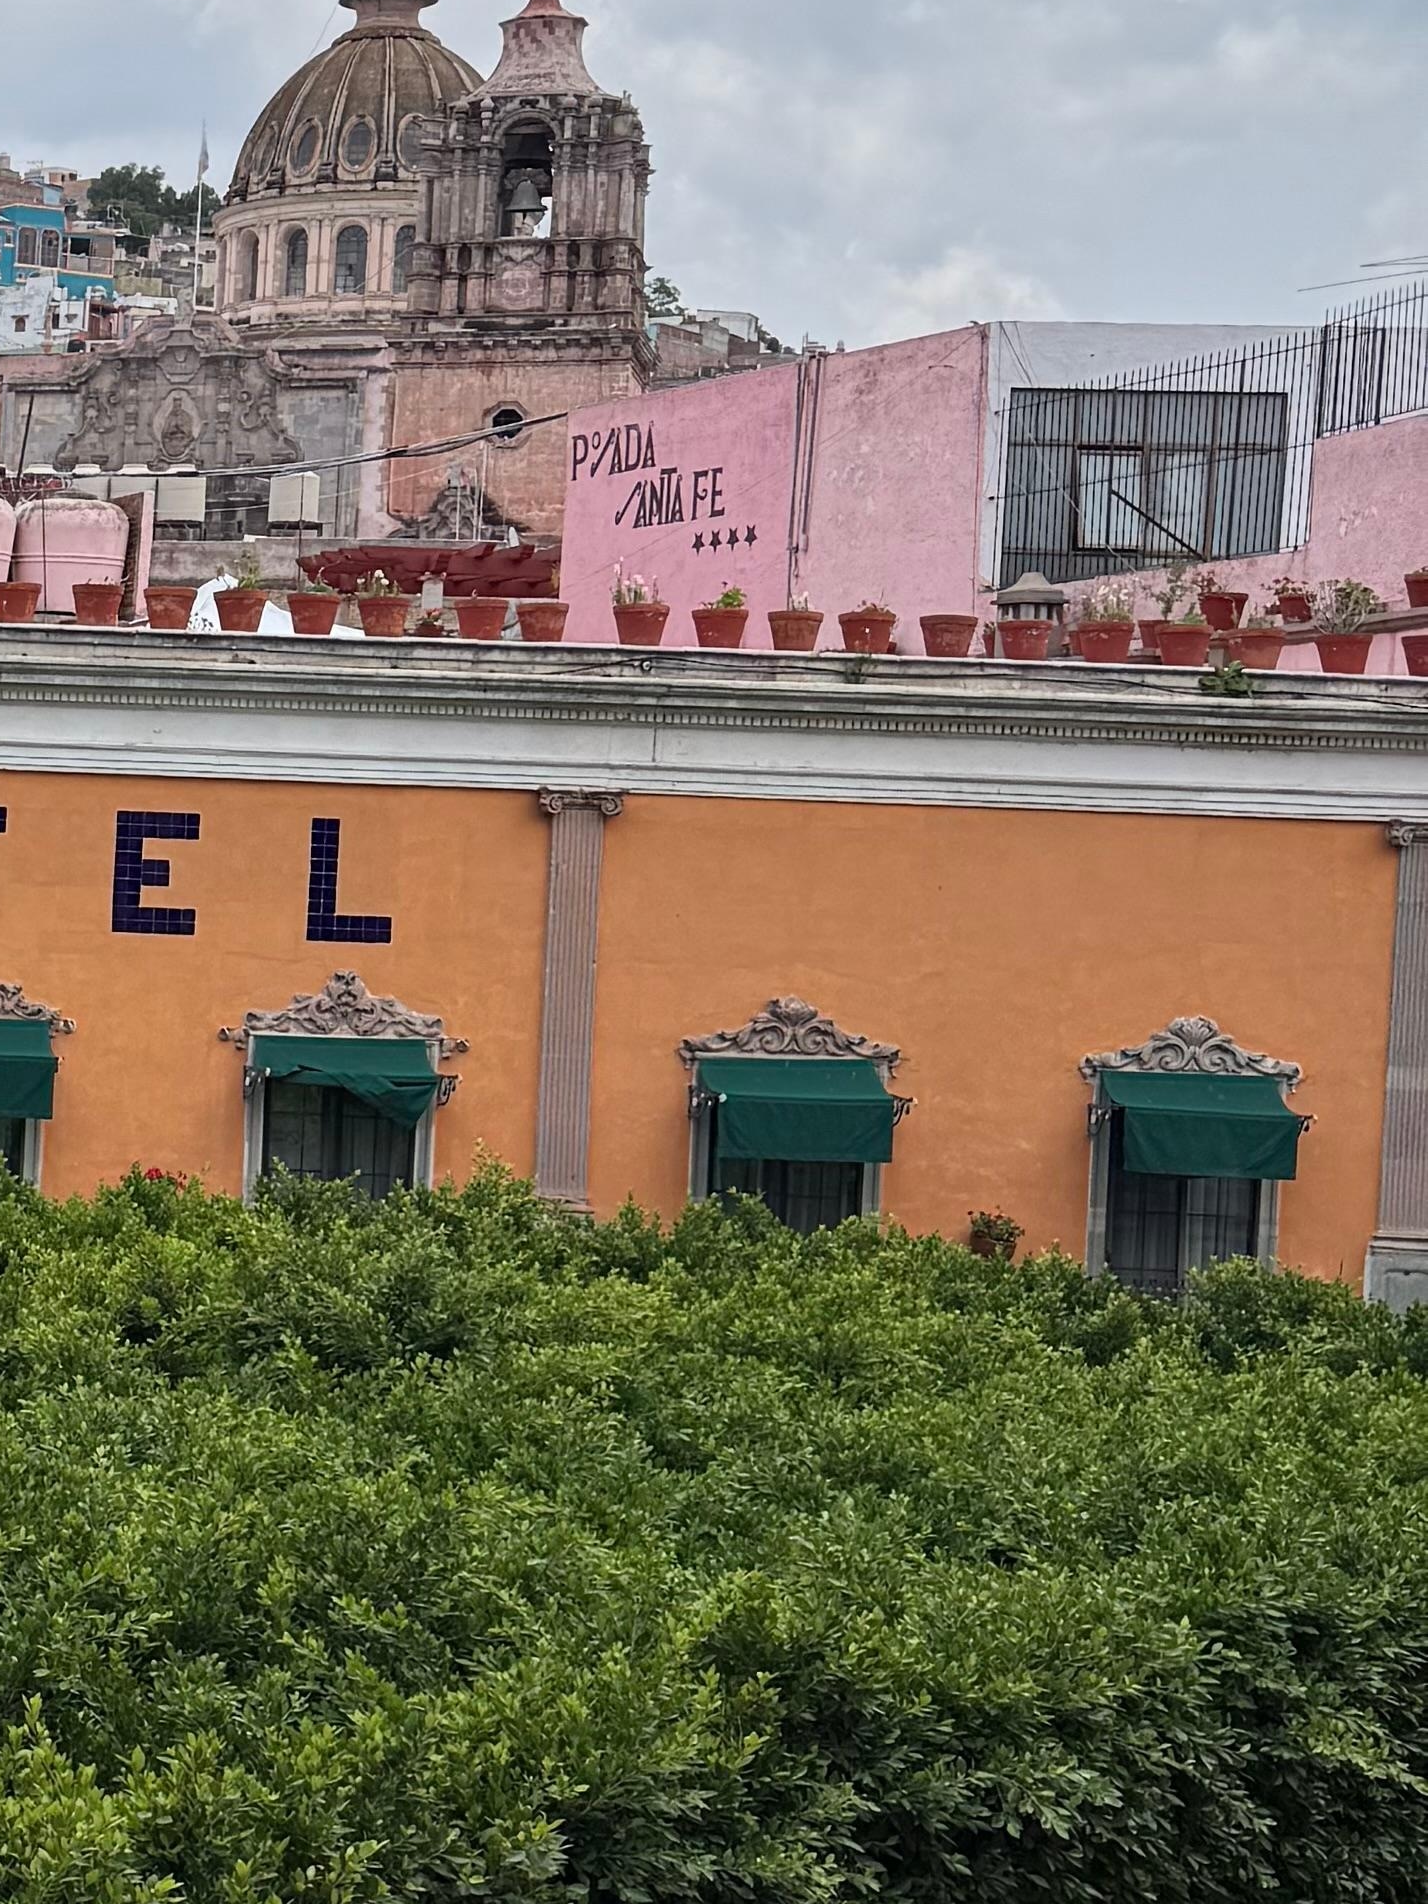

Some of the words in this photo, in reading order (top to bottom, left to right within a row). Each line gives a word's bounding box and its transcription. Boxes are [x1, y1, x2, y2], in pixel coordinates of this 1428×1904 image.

[570, 420, 657, 481] POSADA
[615, 467, 685, 529] SANTA
[690, 467, 725, 521] FE
